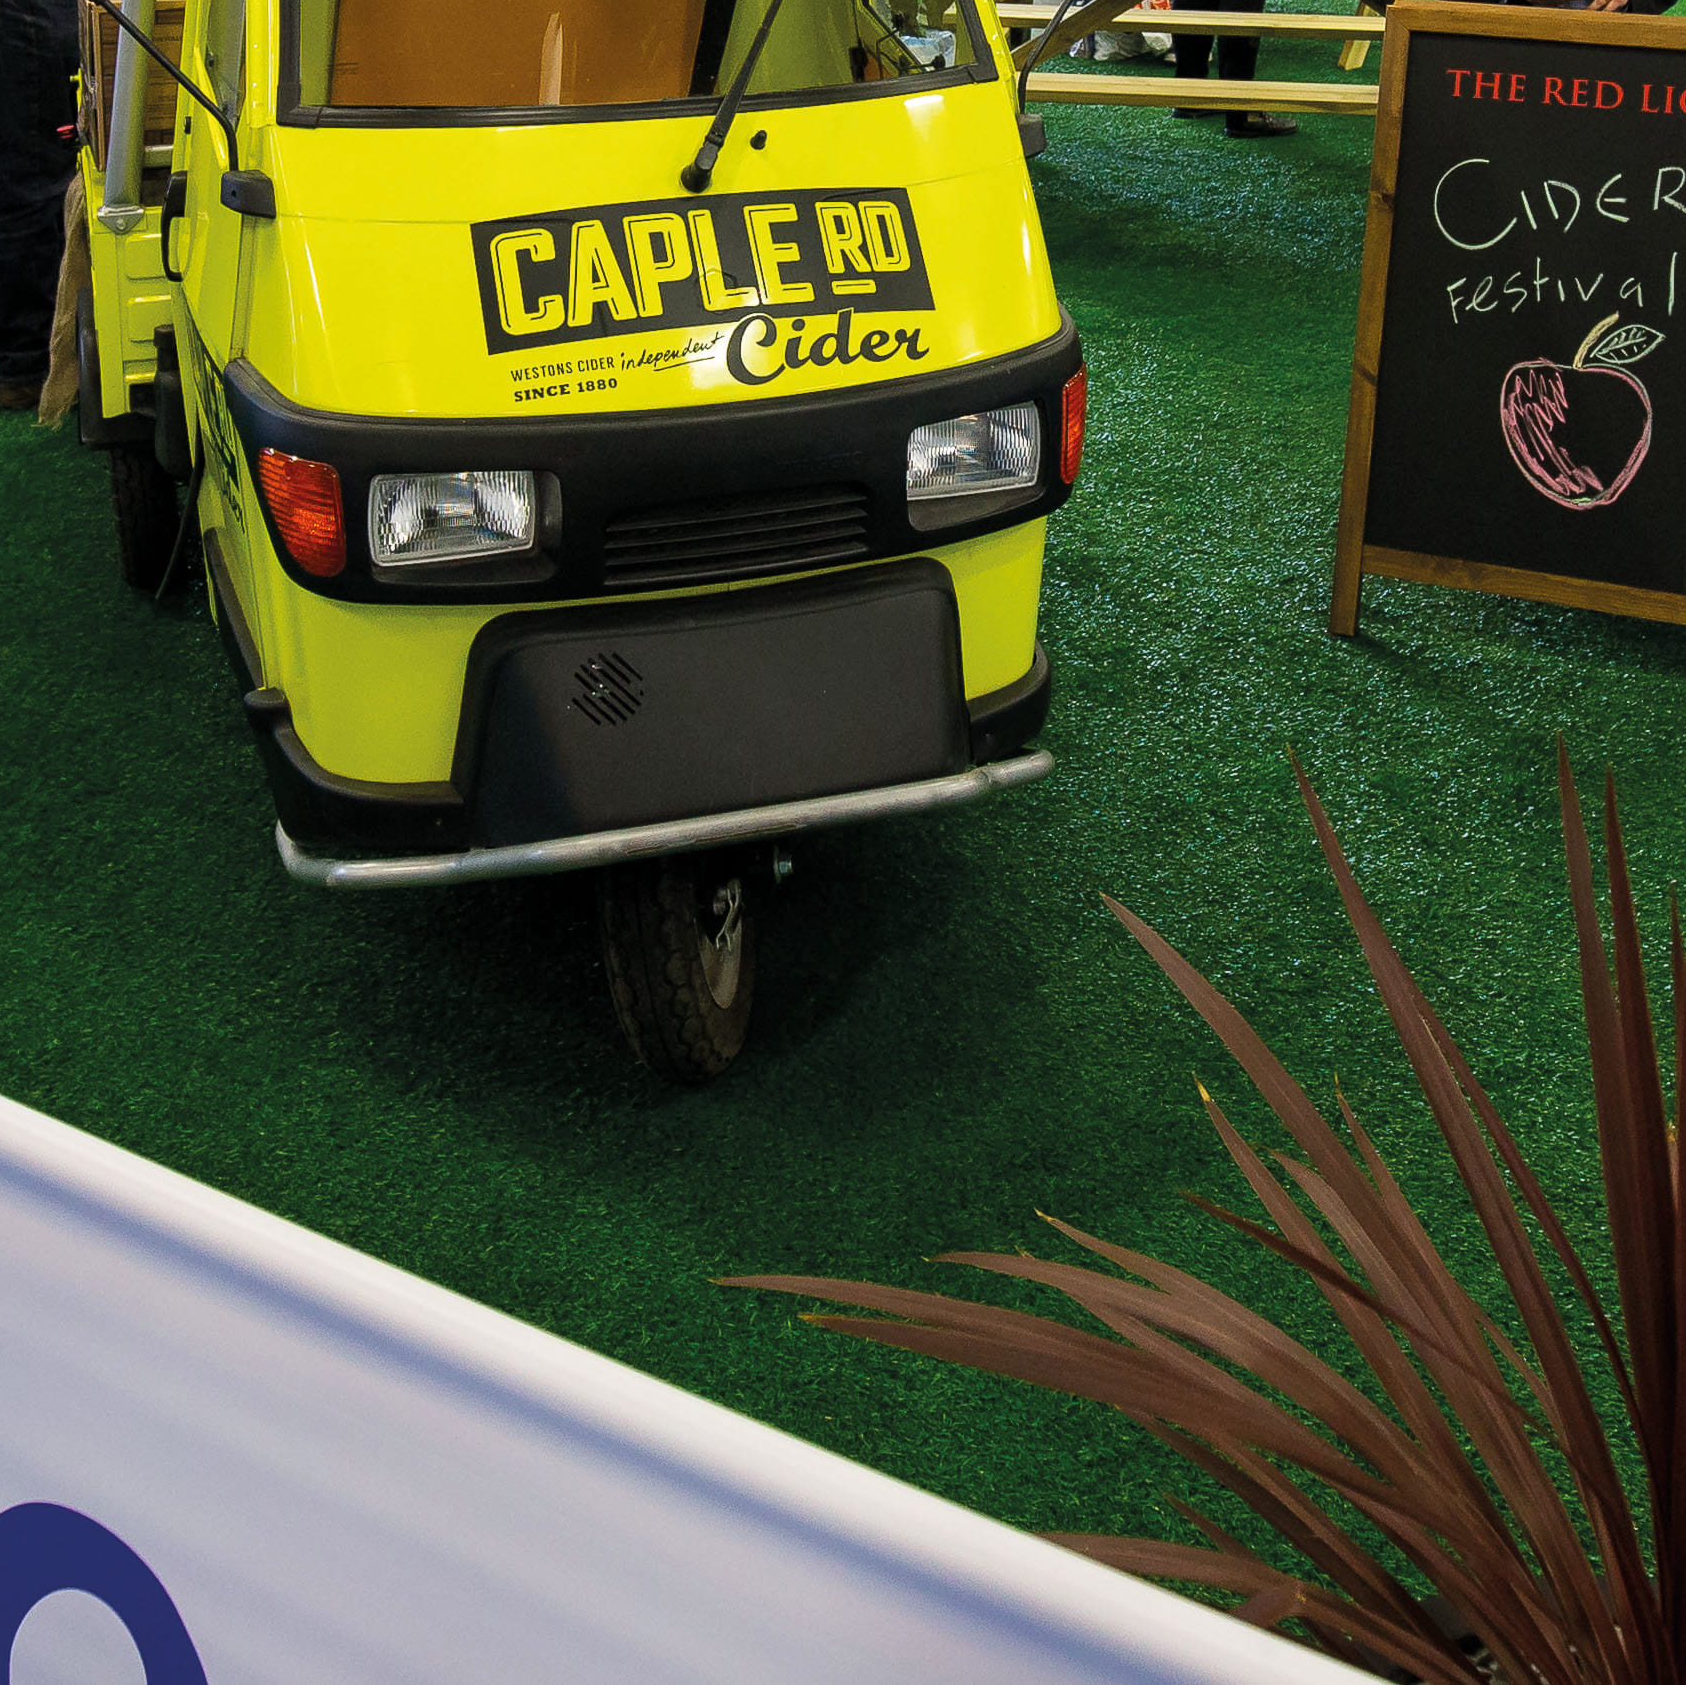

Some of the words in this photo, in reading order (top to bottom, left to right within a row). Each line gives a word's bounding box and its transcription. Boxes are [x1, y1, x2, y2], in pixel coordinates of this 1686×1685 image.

[1445, 68, 1527, 103] THE
[1542, 77, 1625, 111] RED
[489, 202, 815, 336] CAPLE
[815, 200, 912, 276] RD
[510, 361, 573, 382] WESTONS
[578, 356, 615, 372] CIDER
[621, 331, 725, 371] independent
[726, 307, 930, 386] Cider
[515, 383, 571, 402] SINCE
[577, 377, 618, 393] 1880
